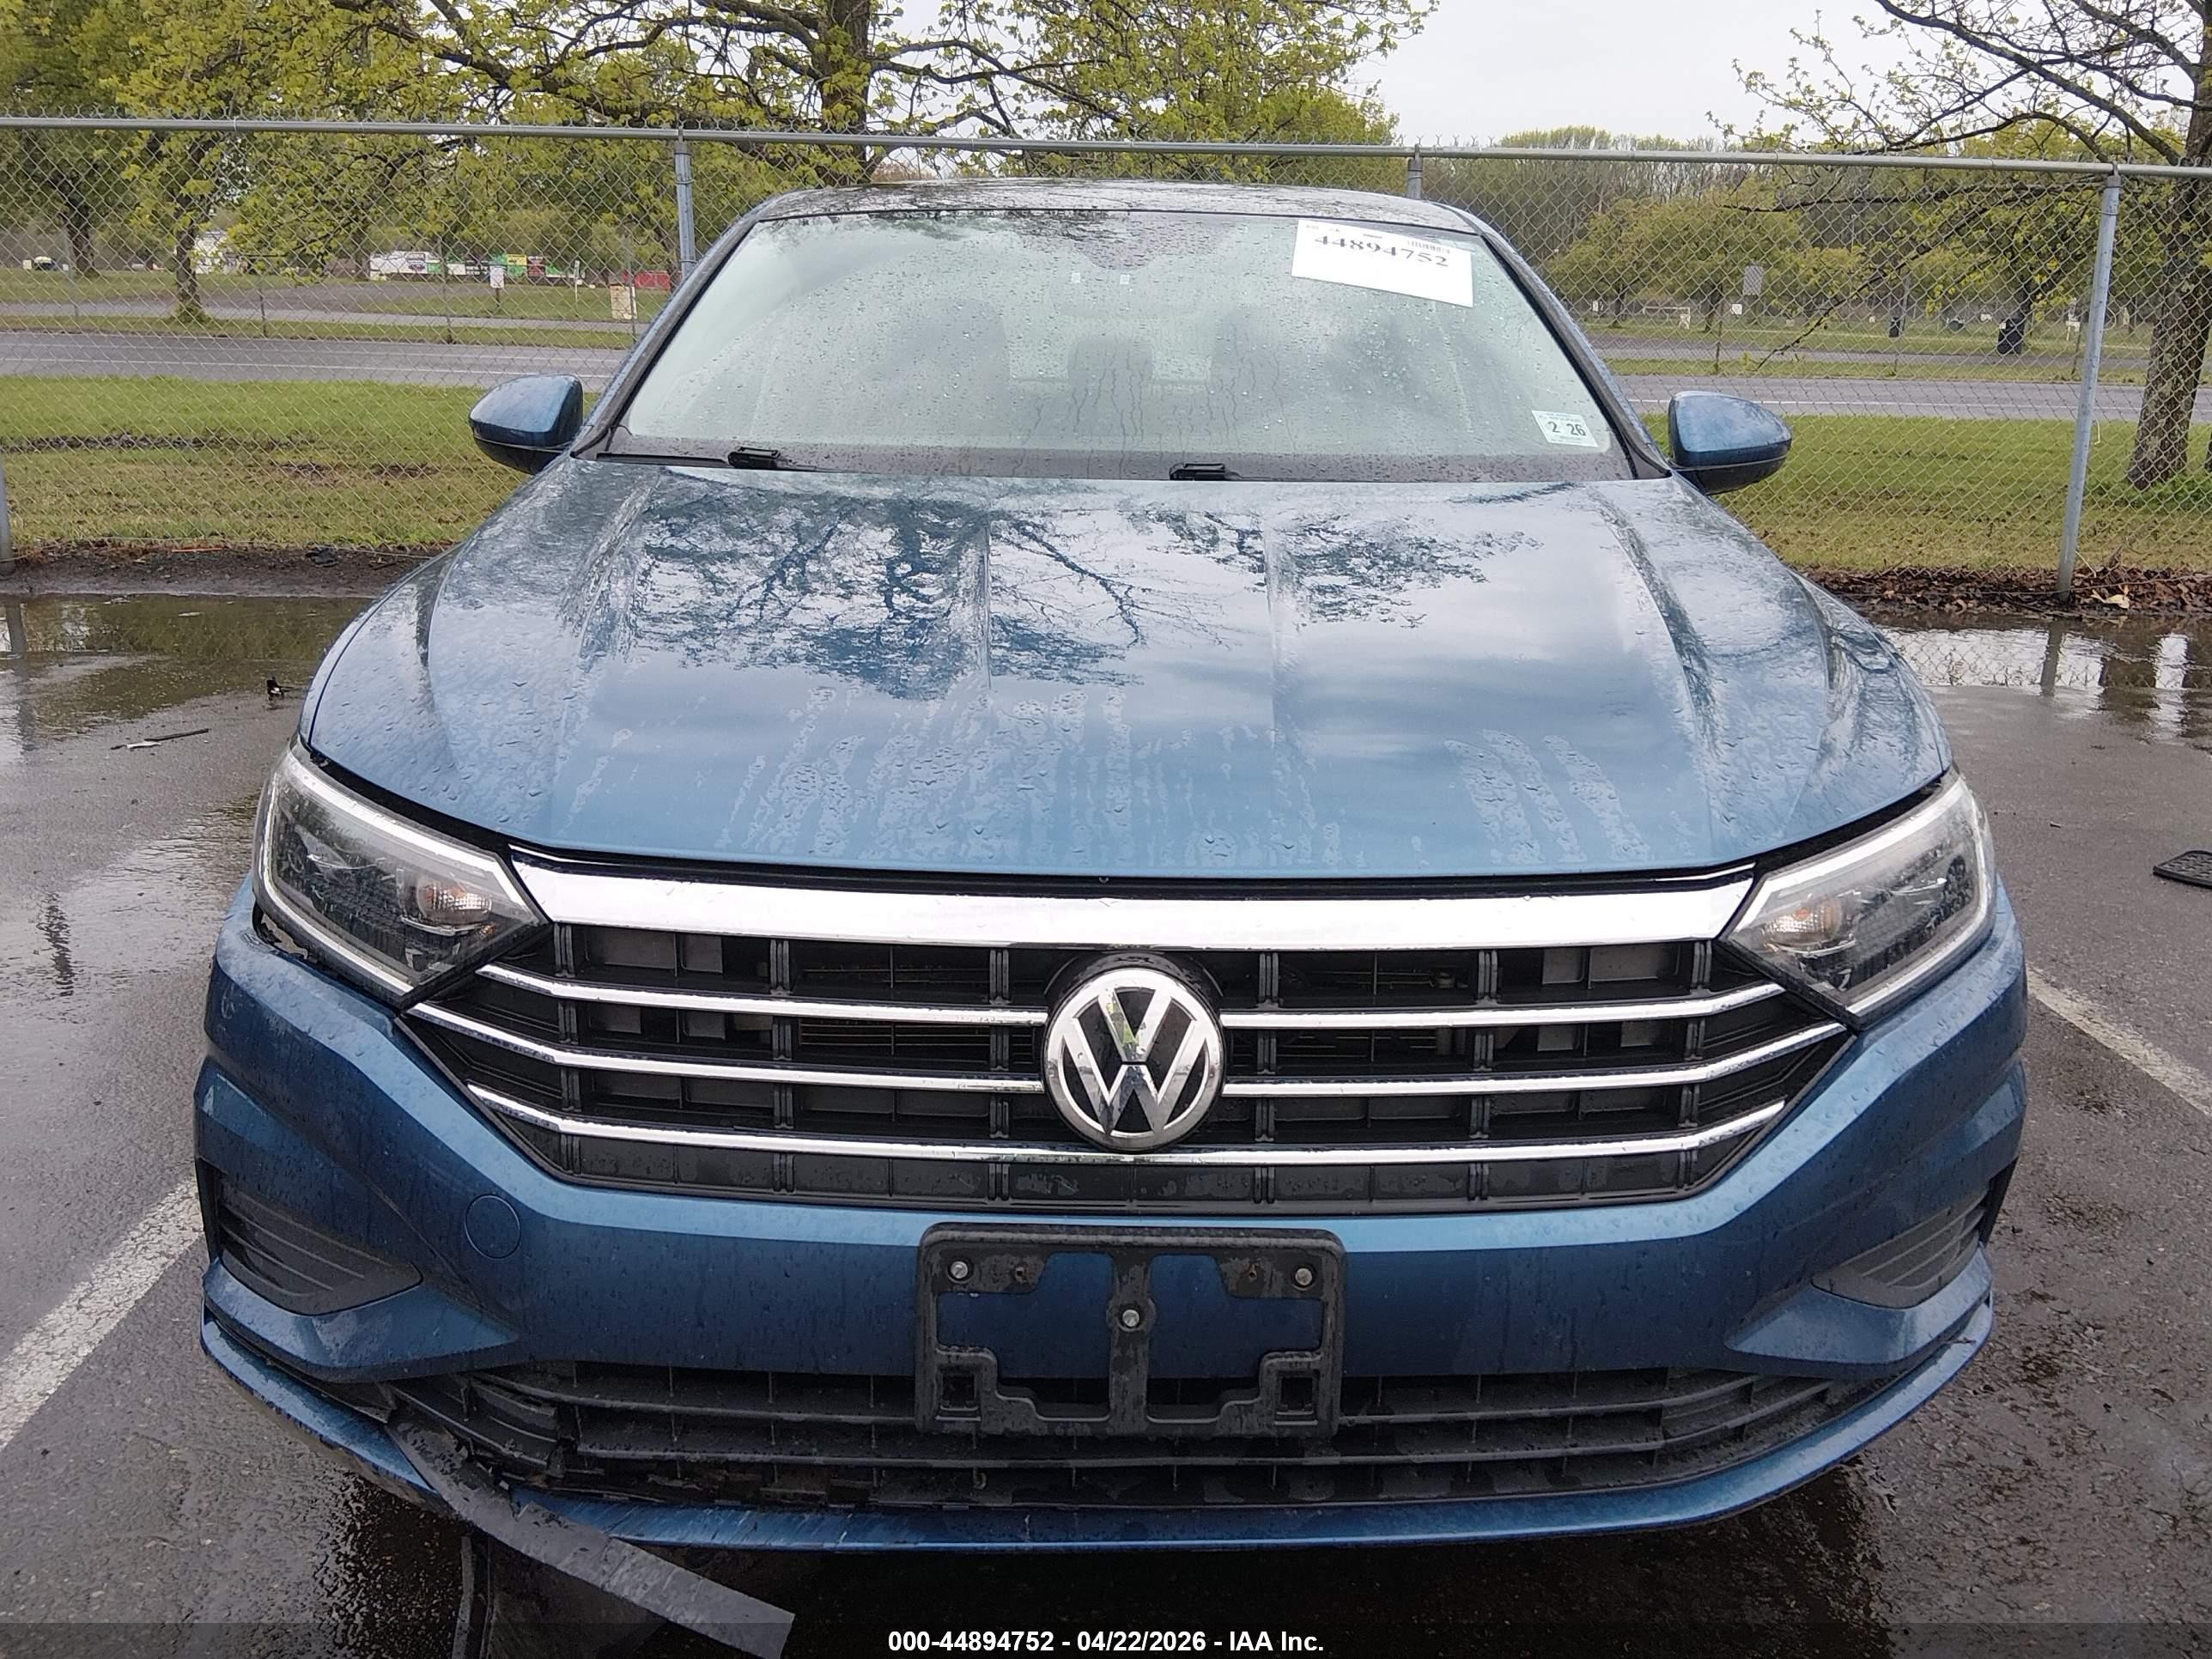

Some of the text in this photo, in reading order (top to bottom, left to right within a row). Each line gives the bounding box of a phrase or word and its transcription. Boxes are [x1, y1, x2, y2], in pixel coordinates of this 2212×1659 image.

[1314, 235, 1449, 267] 44894752
[1547, 421, 1586, 436] 2 26
[1053, 975, 1214, 1142] VW
